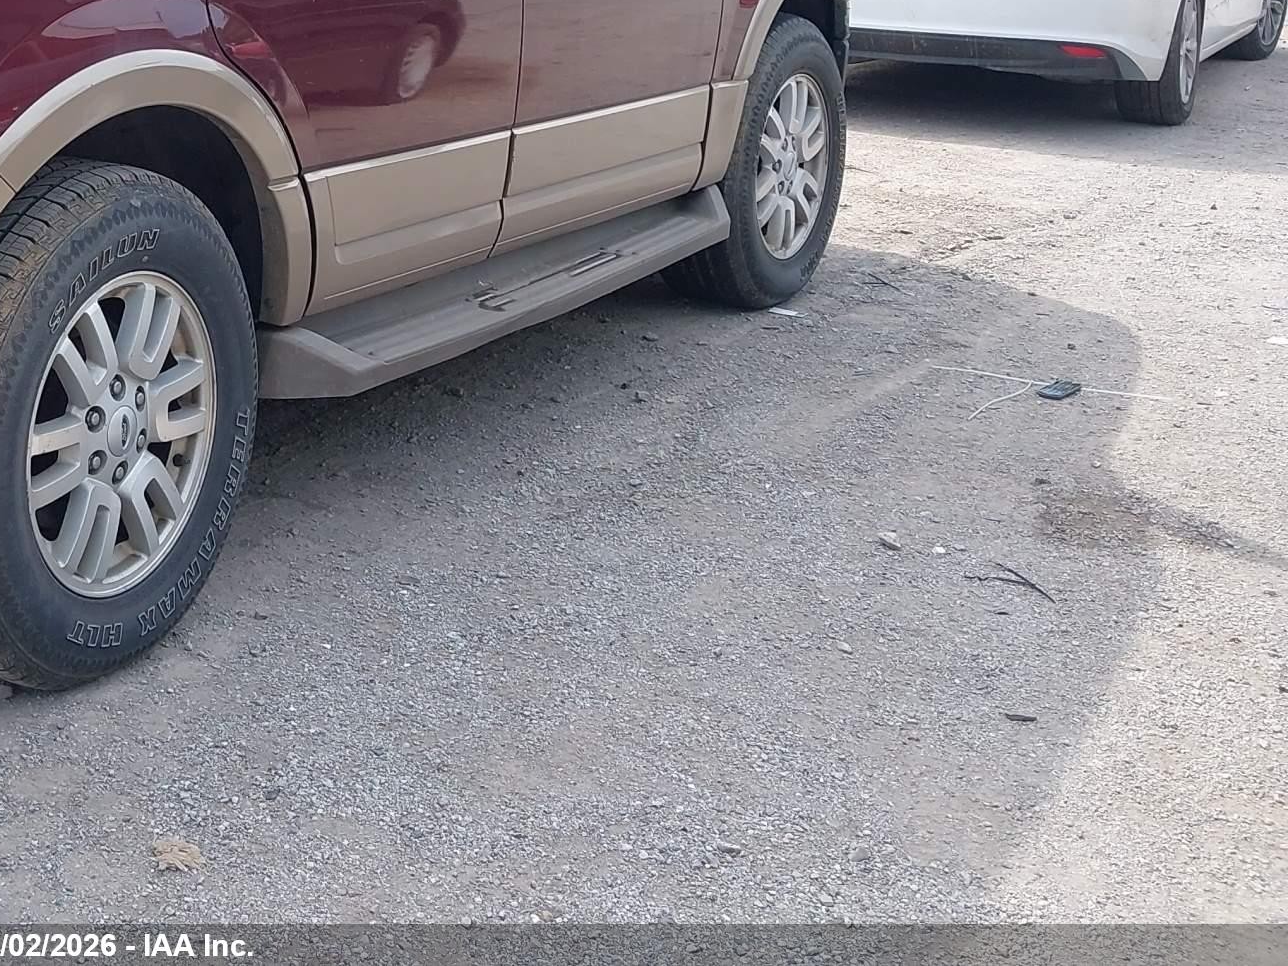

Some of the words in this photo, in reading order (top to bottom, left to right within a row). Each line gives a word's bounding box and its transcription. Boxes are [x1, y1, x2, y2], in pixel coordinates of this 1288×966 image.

[48, 228, 161, 334] SAILUN
[137, 407, 251, 636] TERRAMAX
[66, 620, 124, 648] HLT
